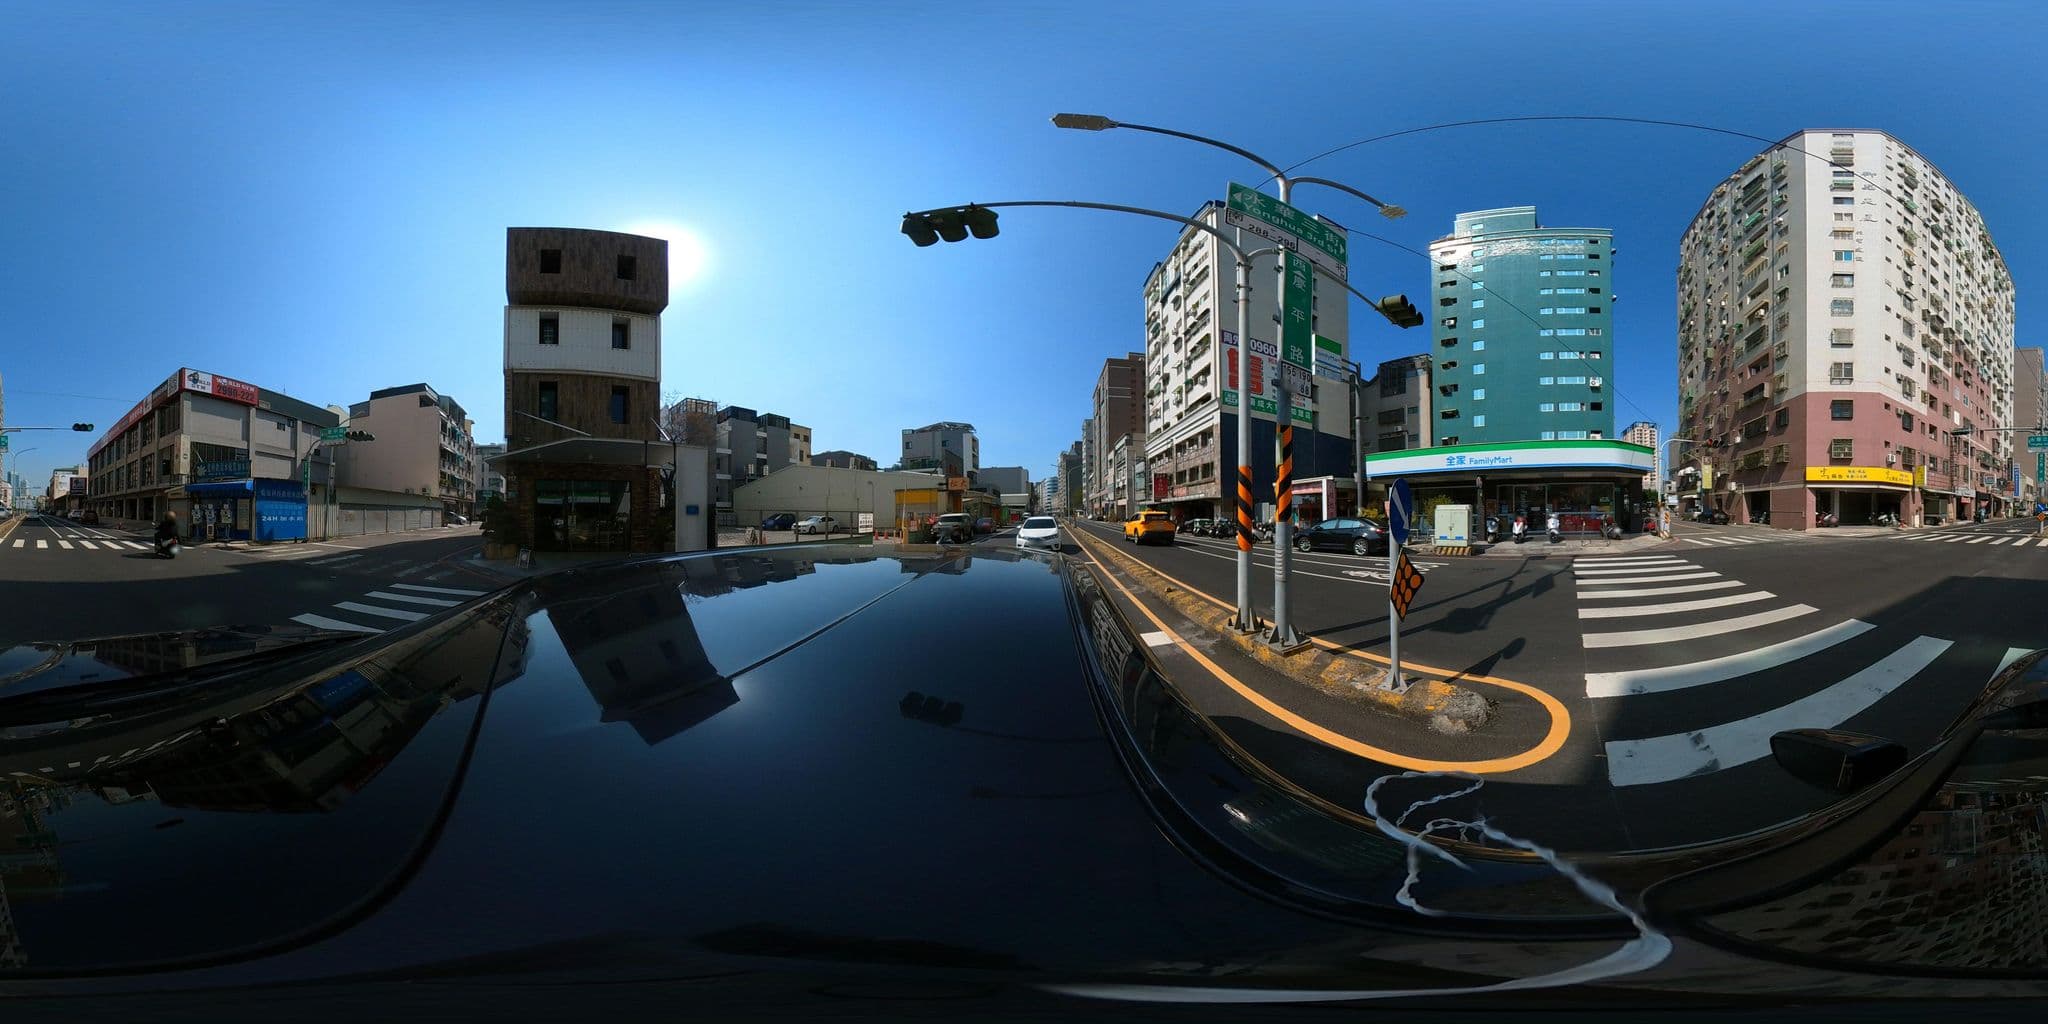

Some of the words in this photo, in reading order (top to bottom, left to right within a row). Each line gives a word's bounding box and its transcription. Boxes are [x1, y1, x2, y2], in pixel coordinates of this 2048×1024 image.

[1243, 202, 1303, 236] Yonghua
[1306, 232, 1325, 248] 3rd
[1245, 191, 1339, 247] 永華三街
[1446, 455, 1466, 466] 全家
[1469, 455, 1512, 465] FamilyMart
